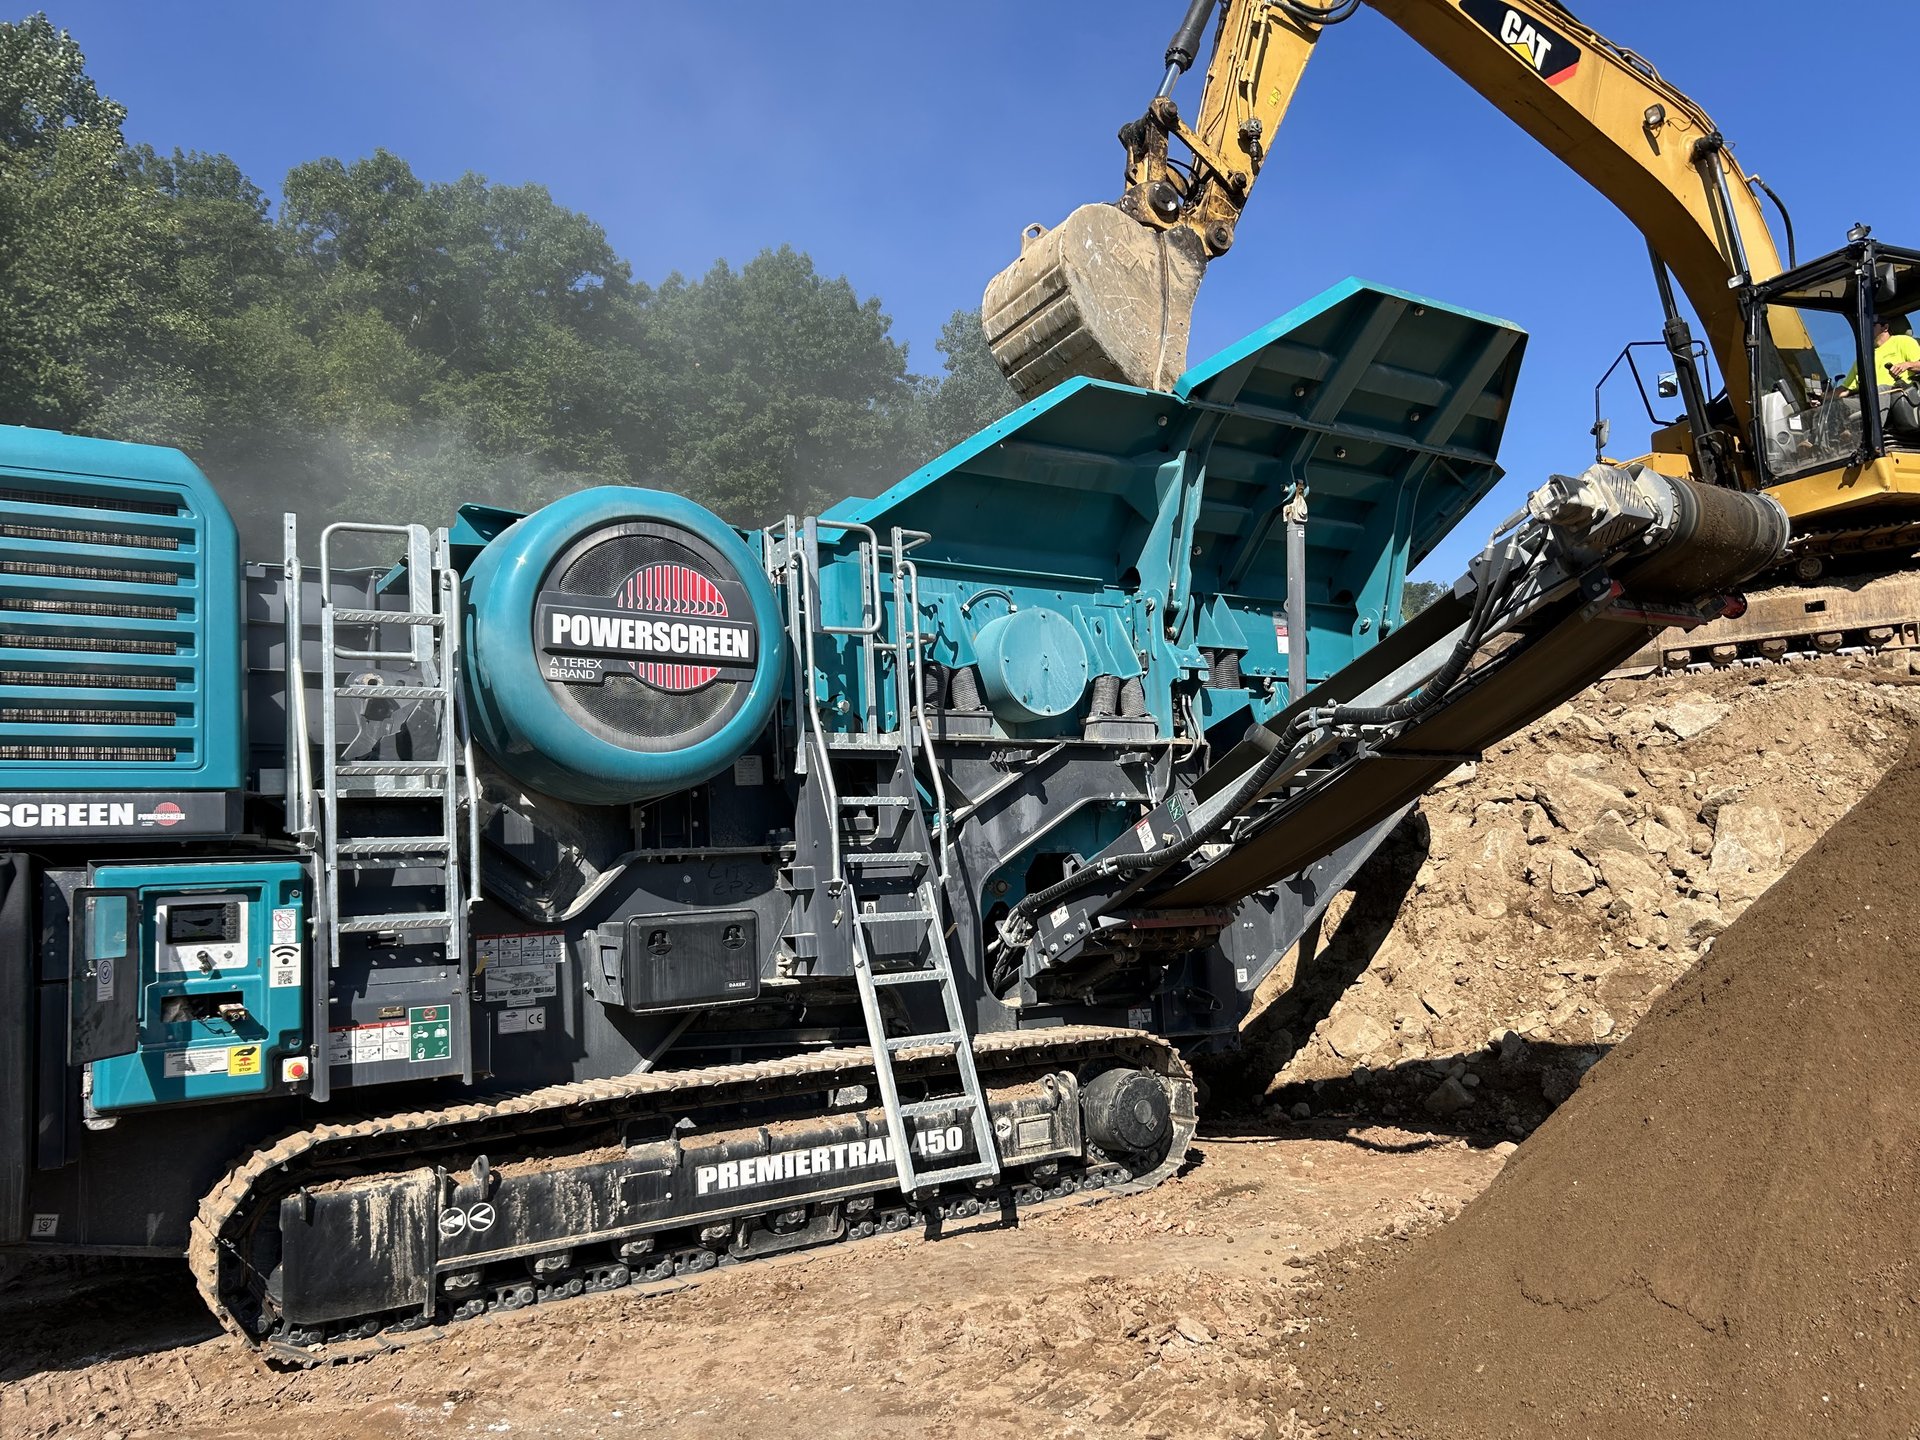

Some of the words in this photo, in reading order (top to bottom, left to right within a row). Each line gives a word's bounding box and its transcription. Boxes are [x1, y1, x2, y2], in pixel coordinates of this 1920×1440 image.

[1500, 9, 1552, 71] CAT
[551, 612, 749, 658] POWERSCREEN
[549, 668, 595, 680] BRAND
[550, 657, 559, 667] A
[561, 657, 603, 669] TEREX
[910, 1126, 963, 1156] 450
